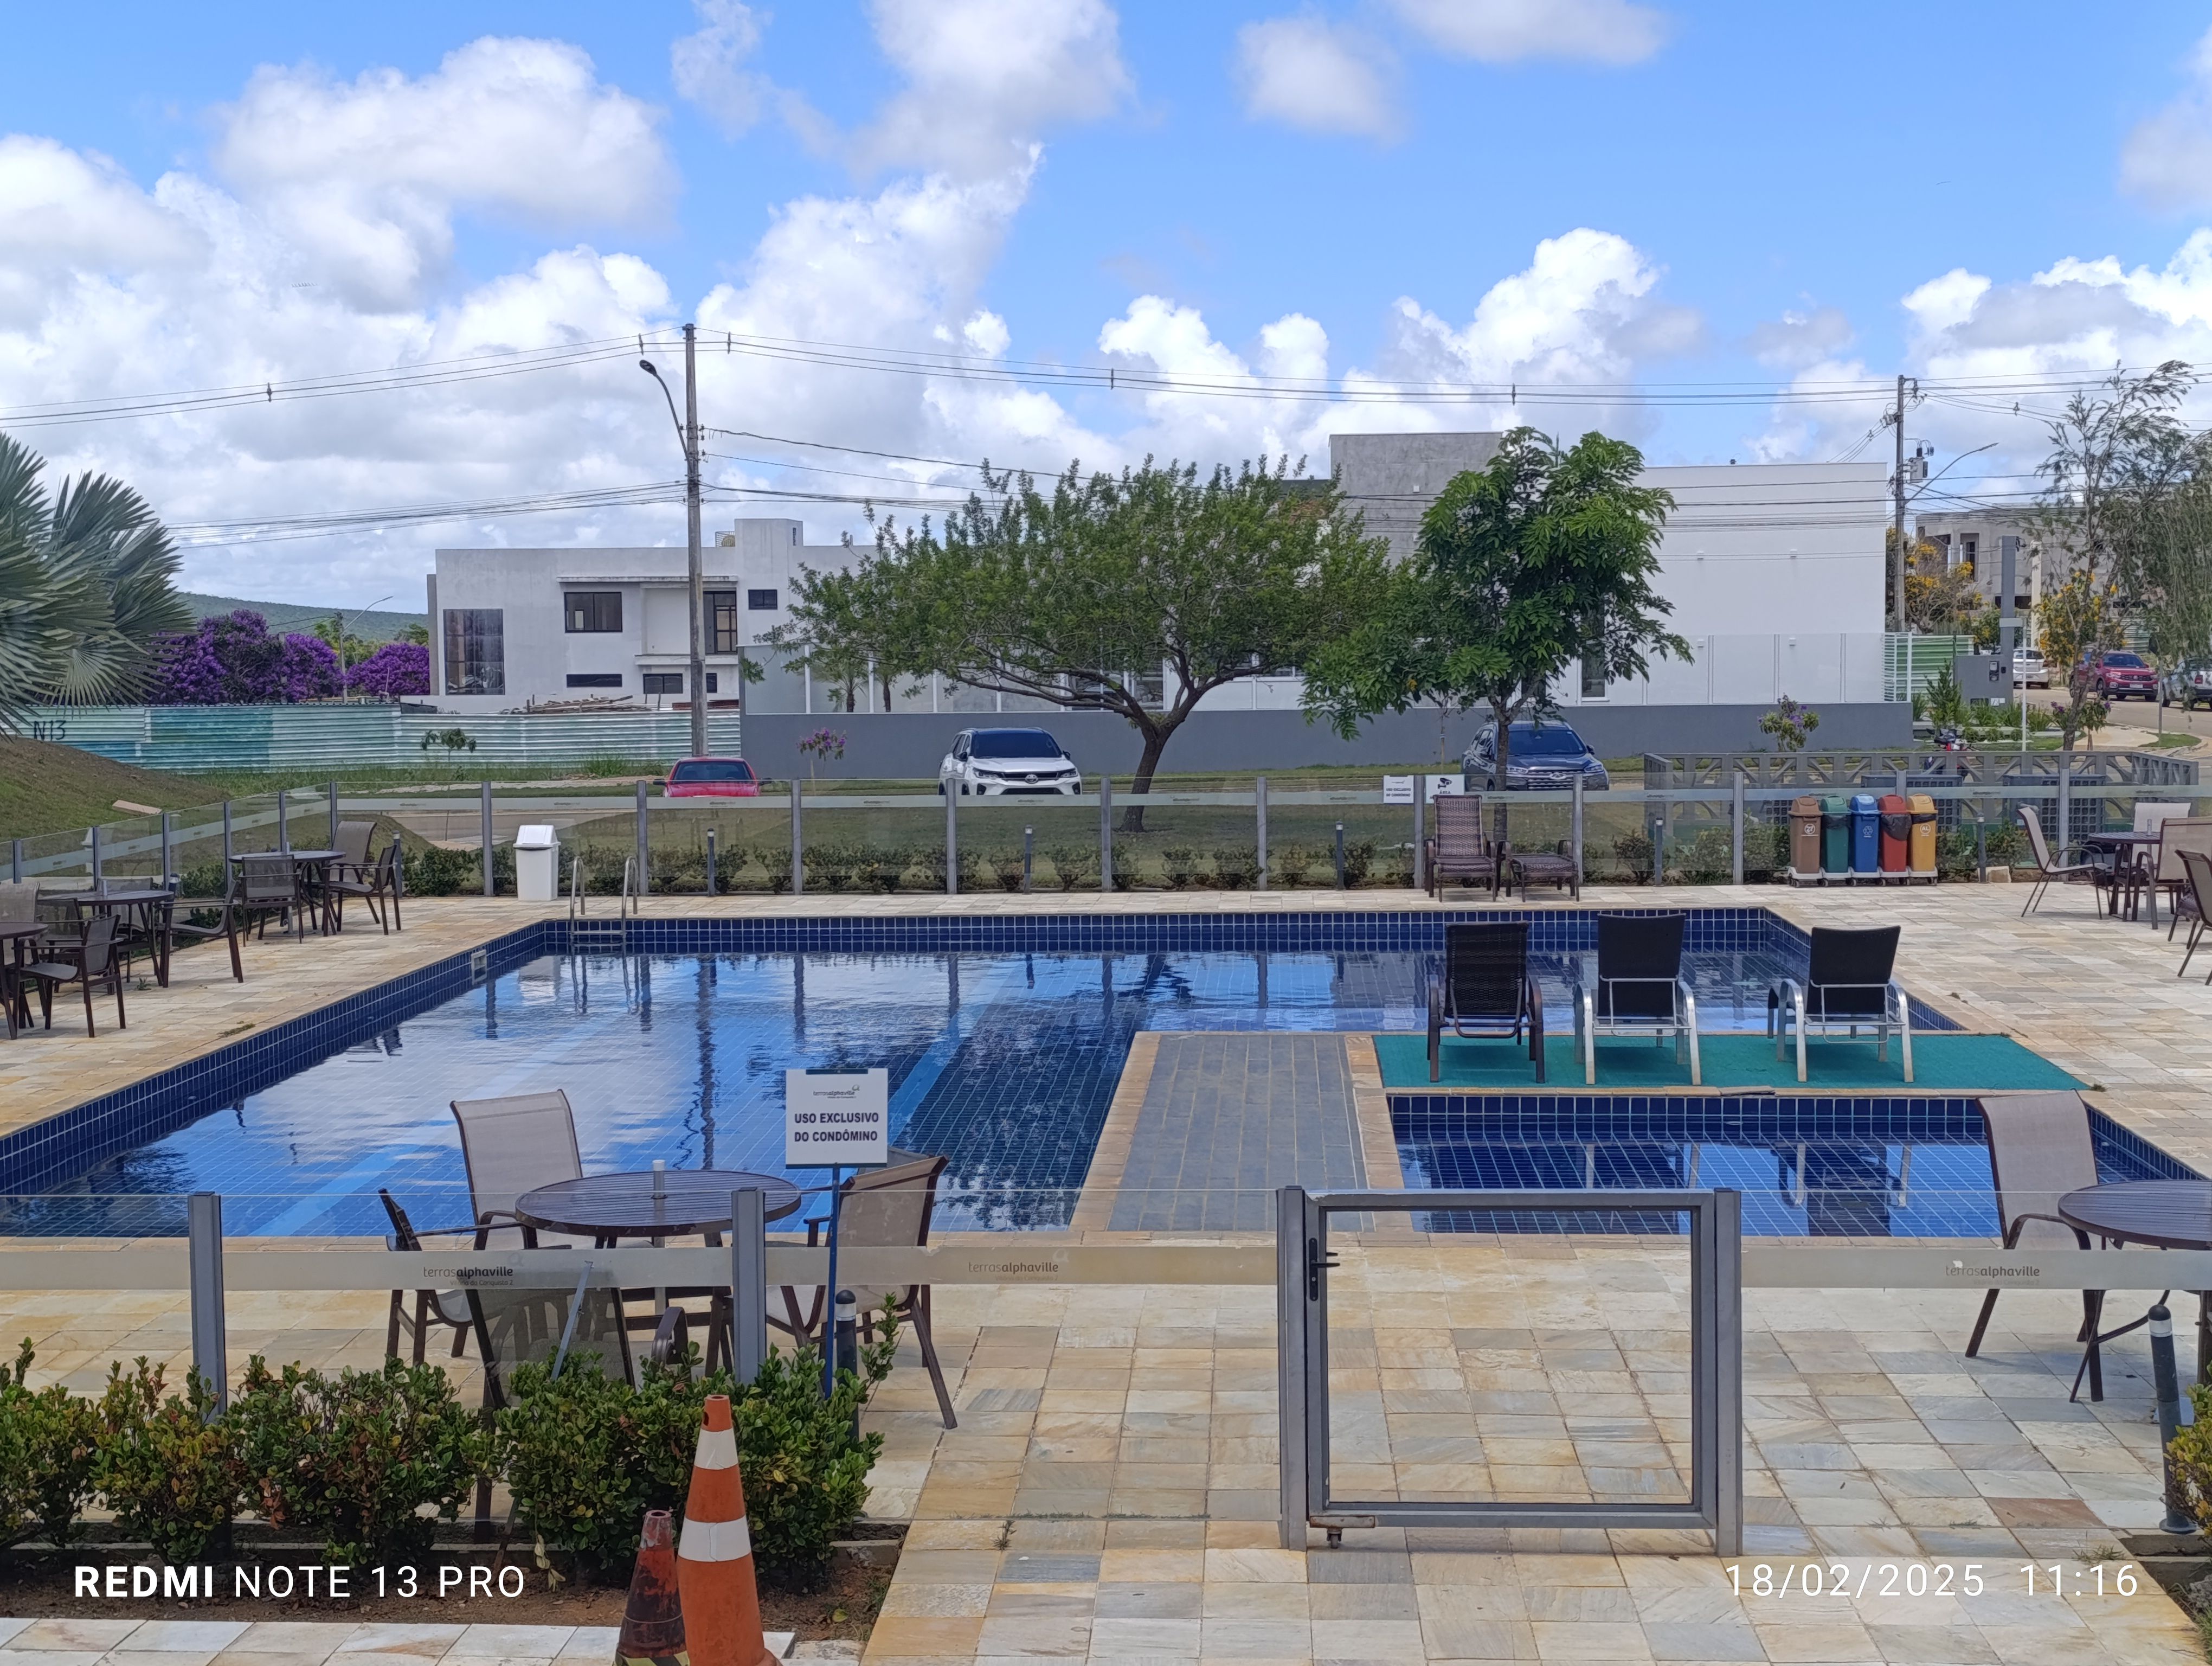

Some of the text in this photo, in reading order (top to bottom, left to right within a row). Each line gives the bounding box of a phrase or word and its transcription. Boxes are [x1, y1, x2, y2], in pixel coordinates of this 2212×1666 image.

[794, 1112, 879, 1123] USO EXCLUSIVO
[794, 1129, 878, 1142] DO CONDÔMINO
[423, 1266, 513, 1279] terrasalphaville
[968, 1262, 1058, 1274] terrasalphaville
[1945, 1266, 2040, 1278] terrasalphaville
